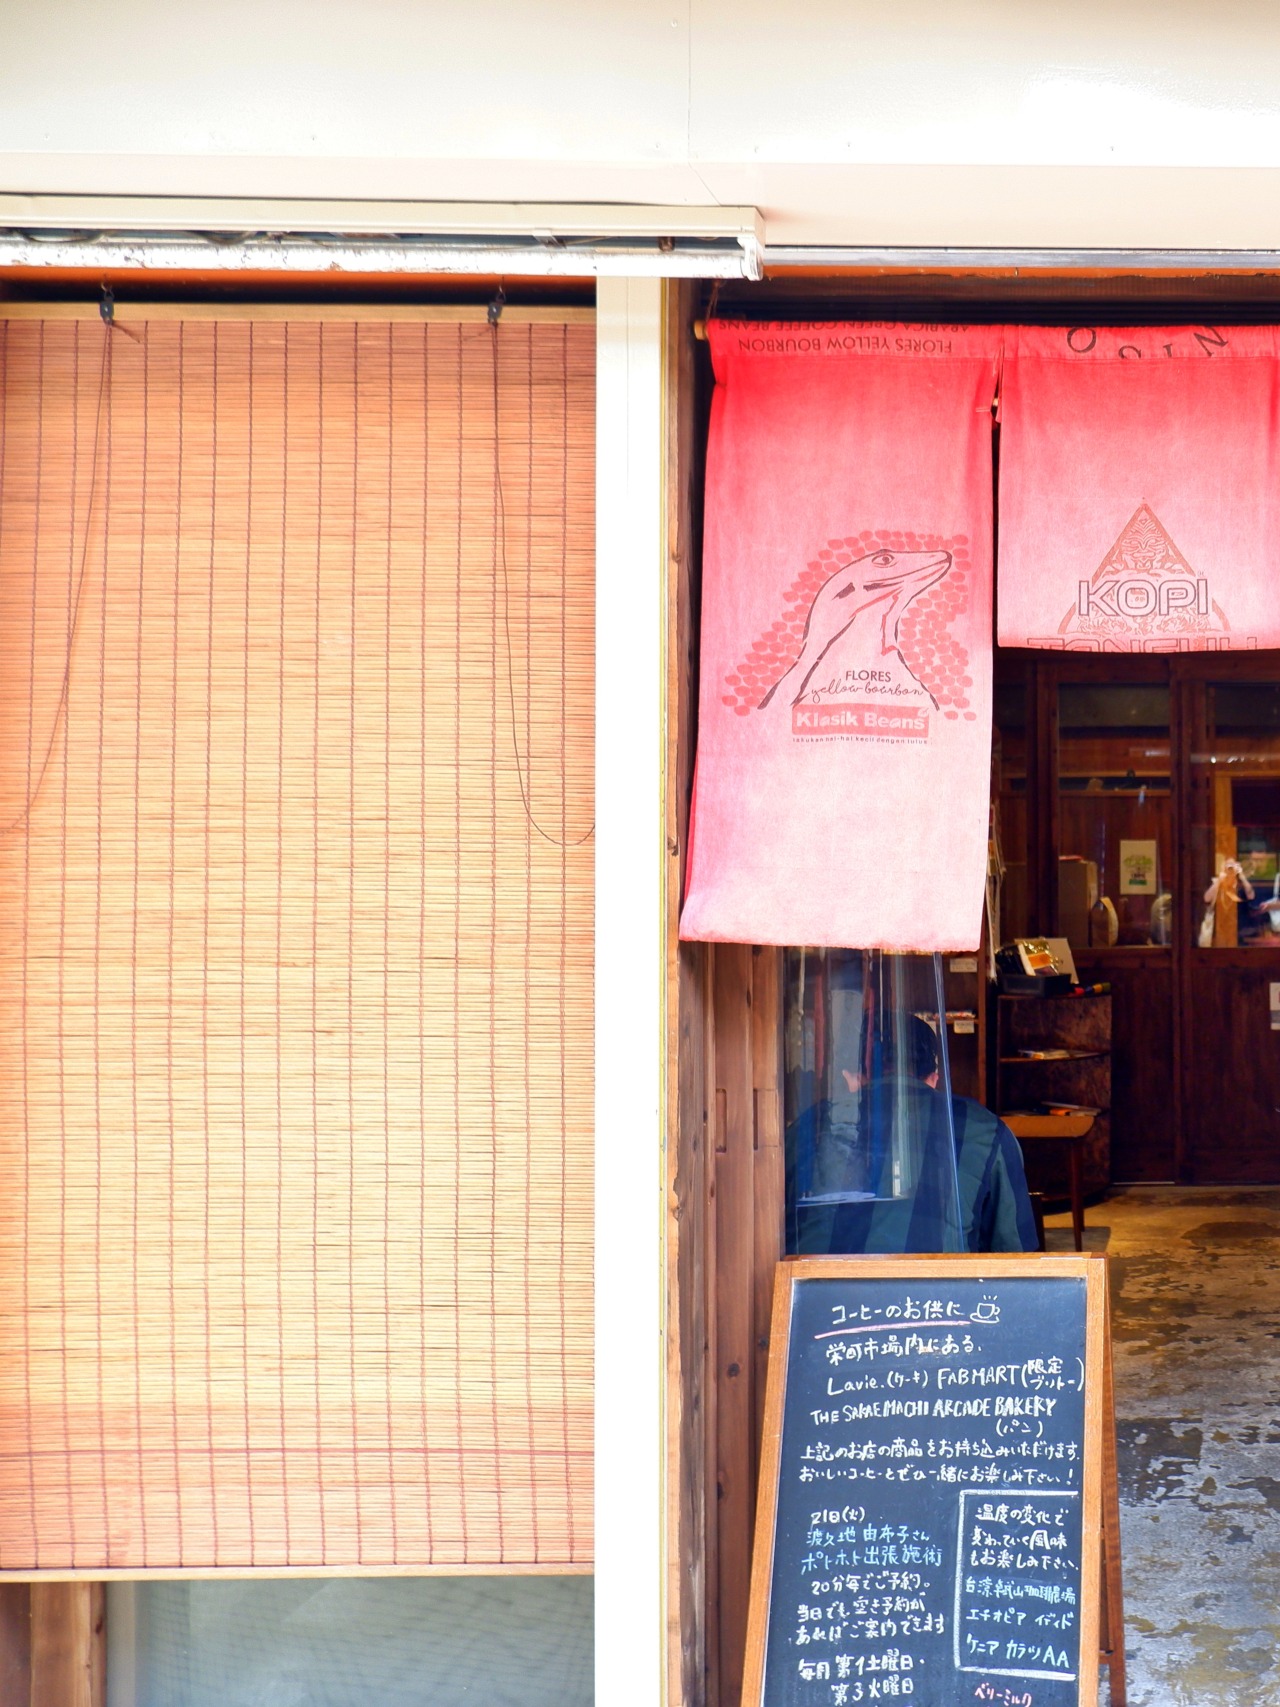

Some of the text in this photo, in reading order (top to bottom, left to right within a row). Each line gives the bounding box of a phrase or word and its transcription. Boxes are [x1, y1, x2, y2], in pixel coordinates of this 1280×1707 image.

[738, 336, 952, 353] FLORES YELLOW BOURBON
[1078, 578, 1208, 617] KOPI
[845, 669, 892, 683] FLORES
[796, 711, 925, 730] Klasik Beans
[831, 1296, 966, 1325] コーヒーのお供に
[810, 1409, 839, 1426] THE
[932, 1398, 992, 1418] ARCADE
[994, 1395, 1057, 1418] BAKERY
[975, 1503, 1069, 1526] 温度の変化で
[971, 1525, 1068, 1550] 変わっていく風味
[966, 1607, 1027, 1626] エチオピア
[966, 1633, 1000, 1656] ケニア
